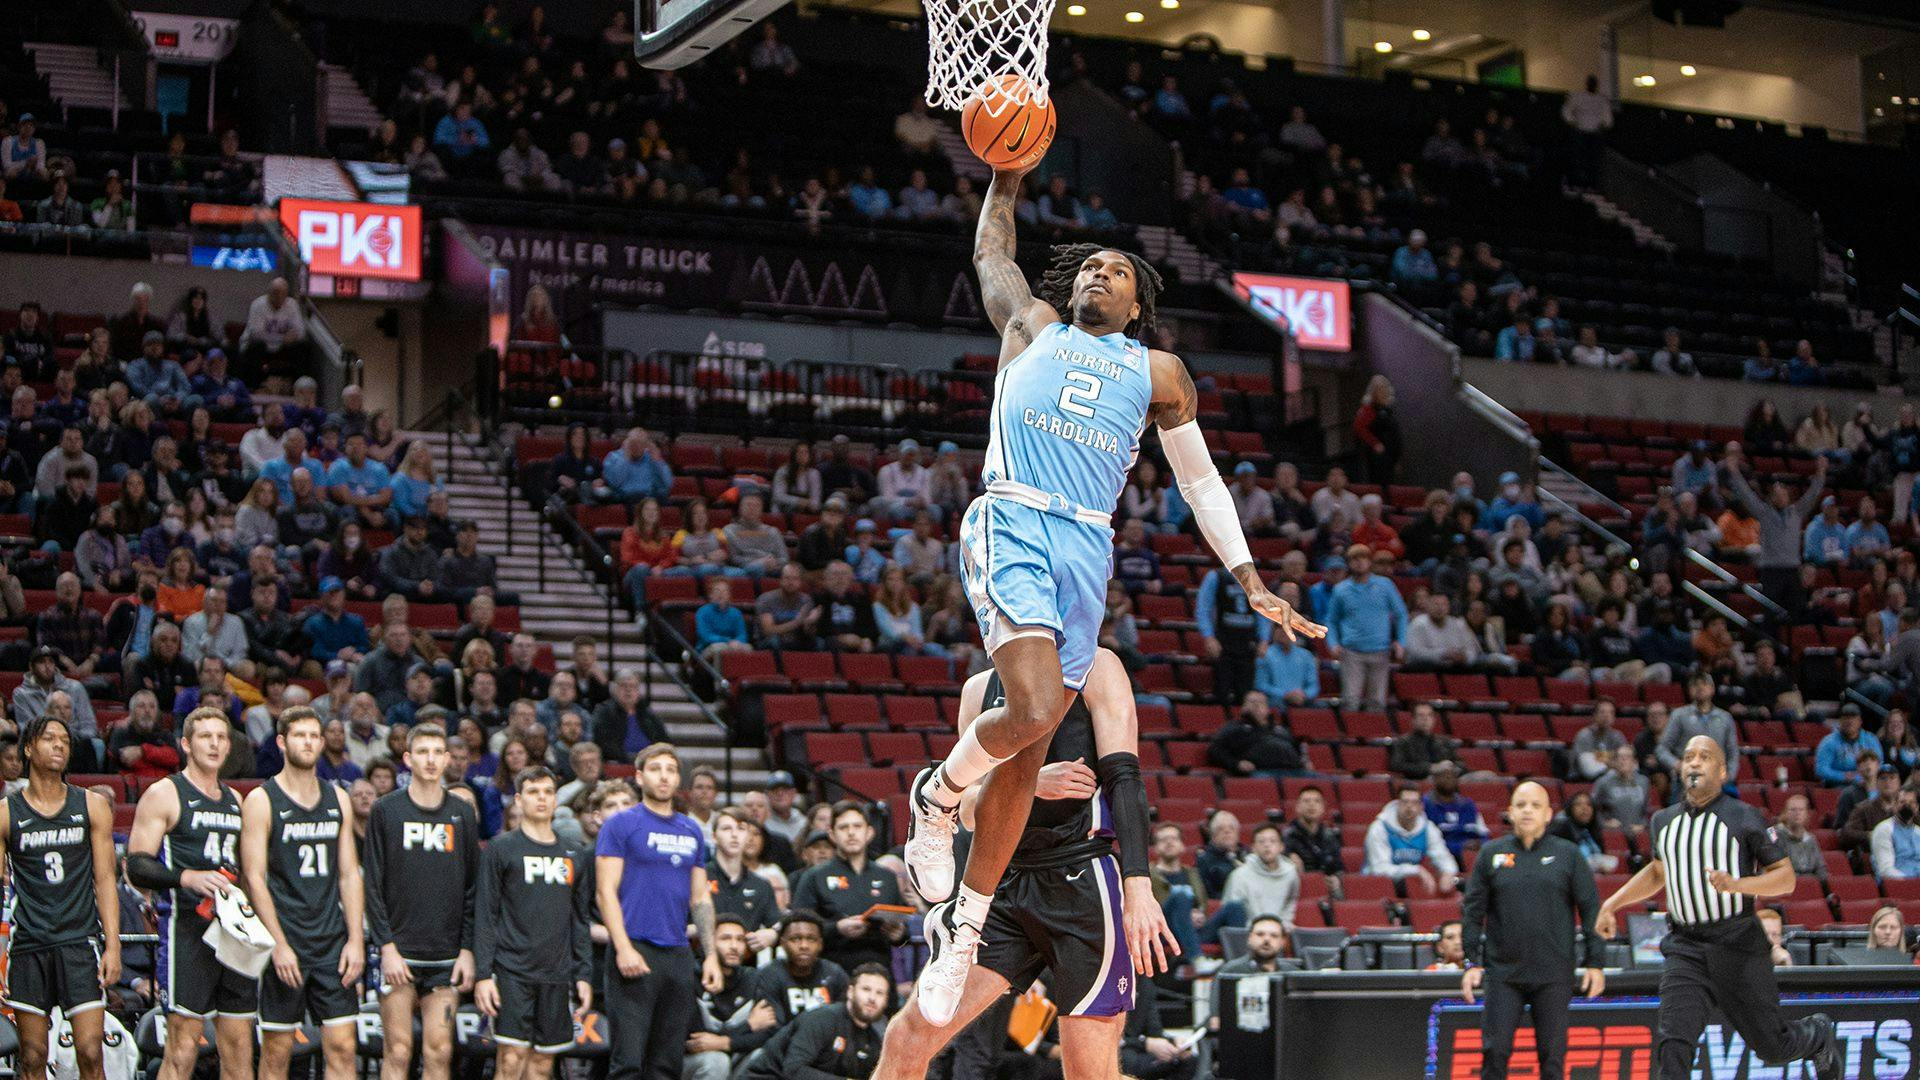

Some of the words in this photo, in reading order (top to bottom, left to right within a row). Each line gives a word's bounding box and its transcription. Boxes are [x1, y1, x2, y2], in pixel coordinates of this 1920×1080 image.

[479, 235, 608, 267] DAIMLER
[624, 245, 712, 274] TRUCK
[1053, 348, 1123, 382] NORTH
[1058, 370, 1103, 420] 2
[1023, 407, 1119, 455] CAROLINA
[191, 811, 242, 831] PORTLAND
[281, 821, 339, 843] PORTLAND
[20, 827, 84, 852] PORTLAND
[44, 851, 65, 884] 3
[298, 843, 329, 878] 21
